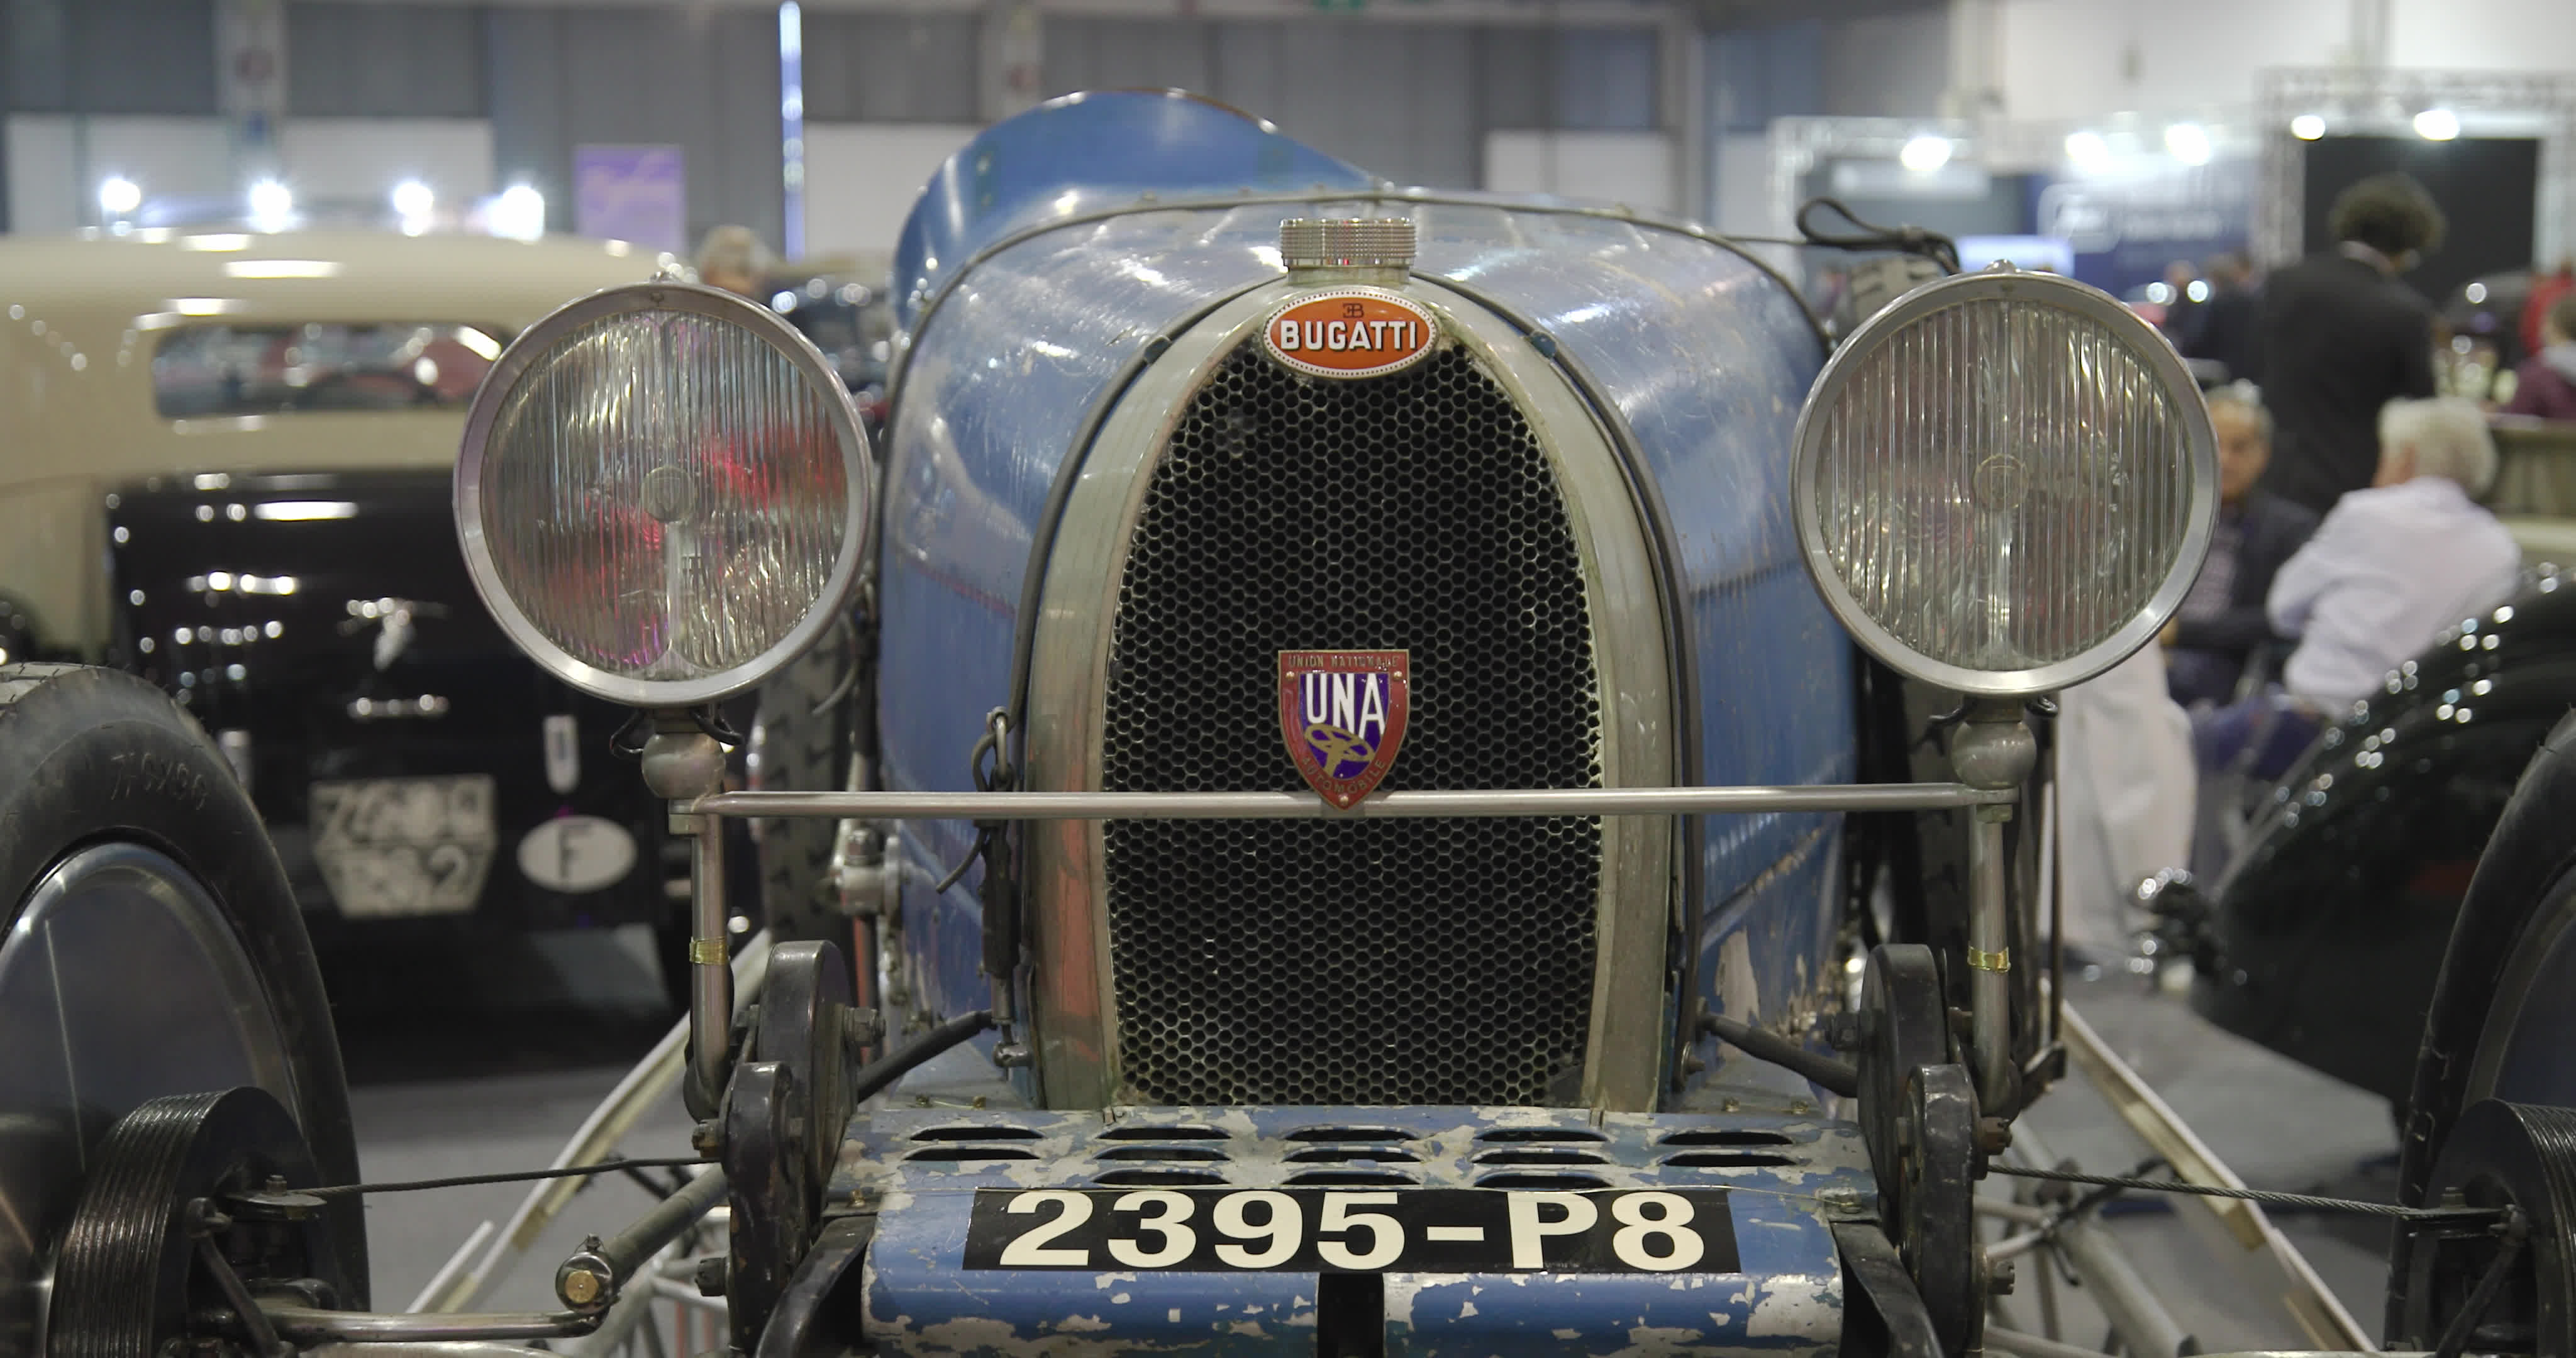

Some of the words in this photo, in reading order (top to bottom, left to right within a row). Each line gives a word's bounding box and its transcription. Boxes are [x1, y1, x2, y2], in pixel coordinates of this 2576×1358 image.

[1280, 320, 1418, 350] BUGATTI
[1289, 654, 1324, 668] UNION
[1306, 673, 1385, 739] UNA
[1302, 758, 1385, 795] AUTOMOBILE
[1000, 1190, 1705, 1271] 2395-P8
